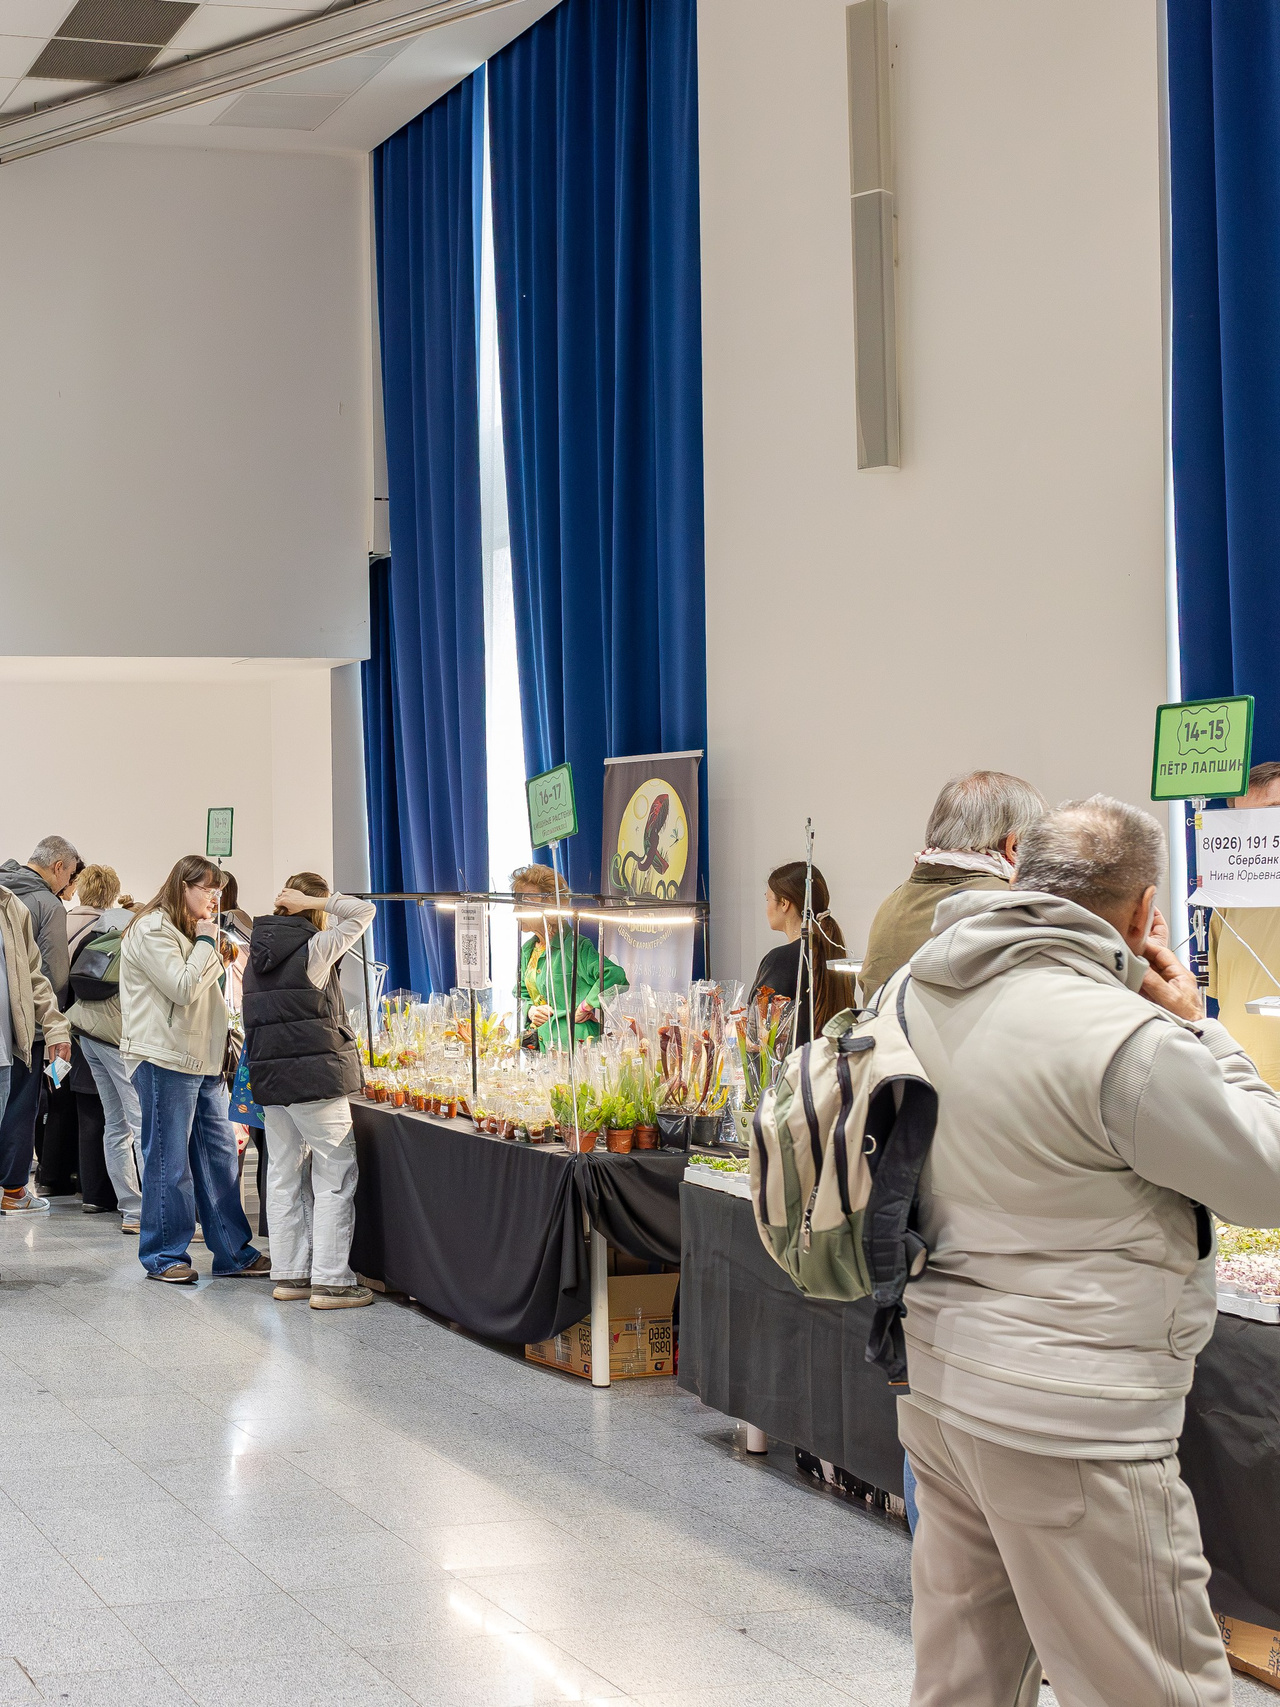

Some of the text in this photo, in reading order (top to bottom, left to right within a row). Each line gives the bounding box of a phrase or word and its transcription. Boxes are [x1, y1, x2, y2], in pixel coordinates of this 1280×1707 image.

[1184, 719, 1224, 742] 14-15
[1159, 760, 1188, 776] ПЁТР
[539, 782, 562, 806] 16-17
[1202, 836, 1242, 853] 8(926)
[1246, 835, 1268, 849] 191
[1228, 854, 1280, 868] Сбербанк
[1209, 870, 1235, 881] Нина
[648, 1326, 671, 1345] seed
[650, 1340, 671, 1358] basil
